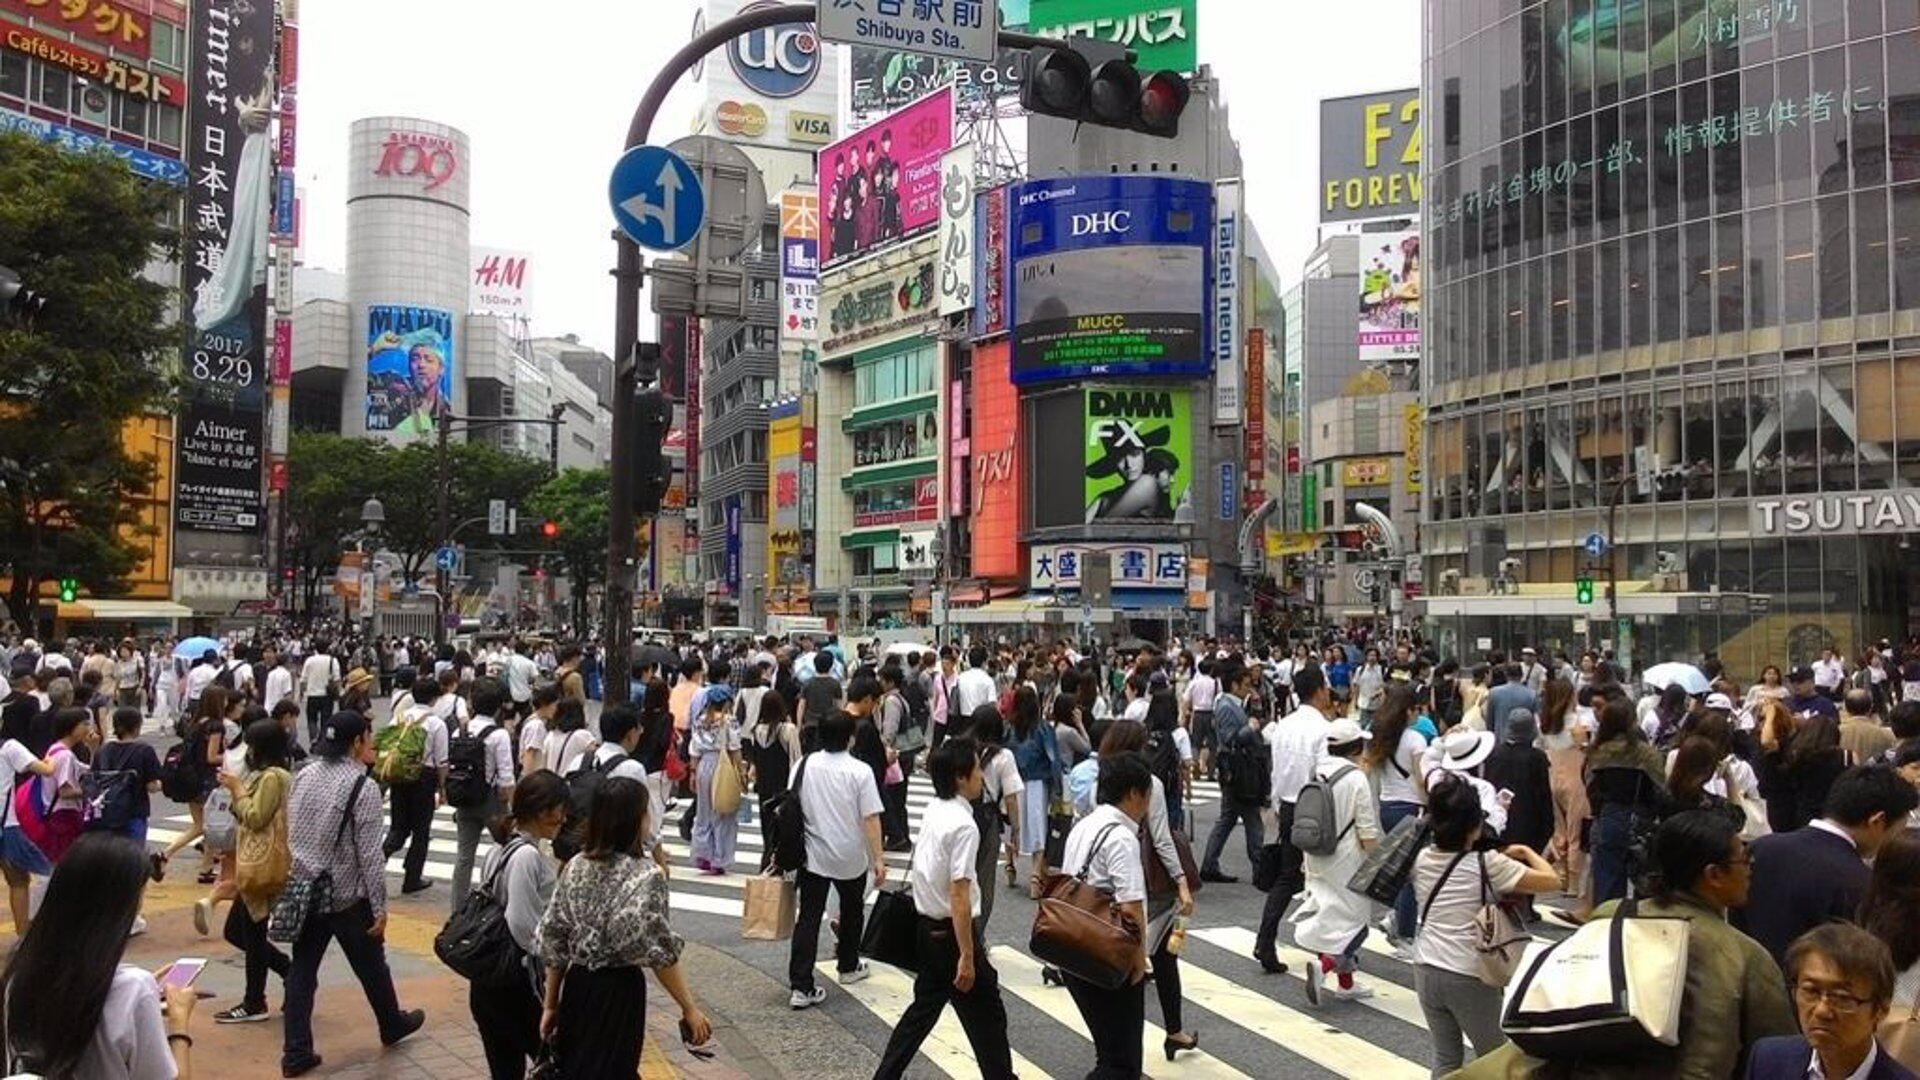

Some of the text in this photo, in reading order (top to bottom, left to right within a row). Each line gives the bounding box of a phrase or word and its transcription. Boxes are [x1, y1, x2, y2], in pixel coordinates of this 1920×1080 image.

[25, 0, 146, 42] タクト
[856, 19, 966, 51] Shibuya Sta.
[104, 60, 171, 102] ガスト
[794, 118, 831, 135] VISA
[374, 142, 457, 190] 109
[1020, 192, 1038, 205] DHC
[943, 164, 971, 306] もんじゃ
[1072, 210, 1131, 236] DHC
[475, 256, 527, 290] H&M
[1219, 211, 1235, 361] Taisei neon
[1077, 315, 1125, 331] MUCC
[204, 333, 243, 355] 2017
[192, 350, 253, 387] 8.29
[1089, 390, 1174, 418] DMM
[184, 437, 208, 451] Live
[194, 419, 247, 442] Aimer
[1089, 420, 1145, 447] FX
[1037, 550, 1184, 579] 大盛書店
